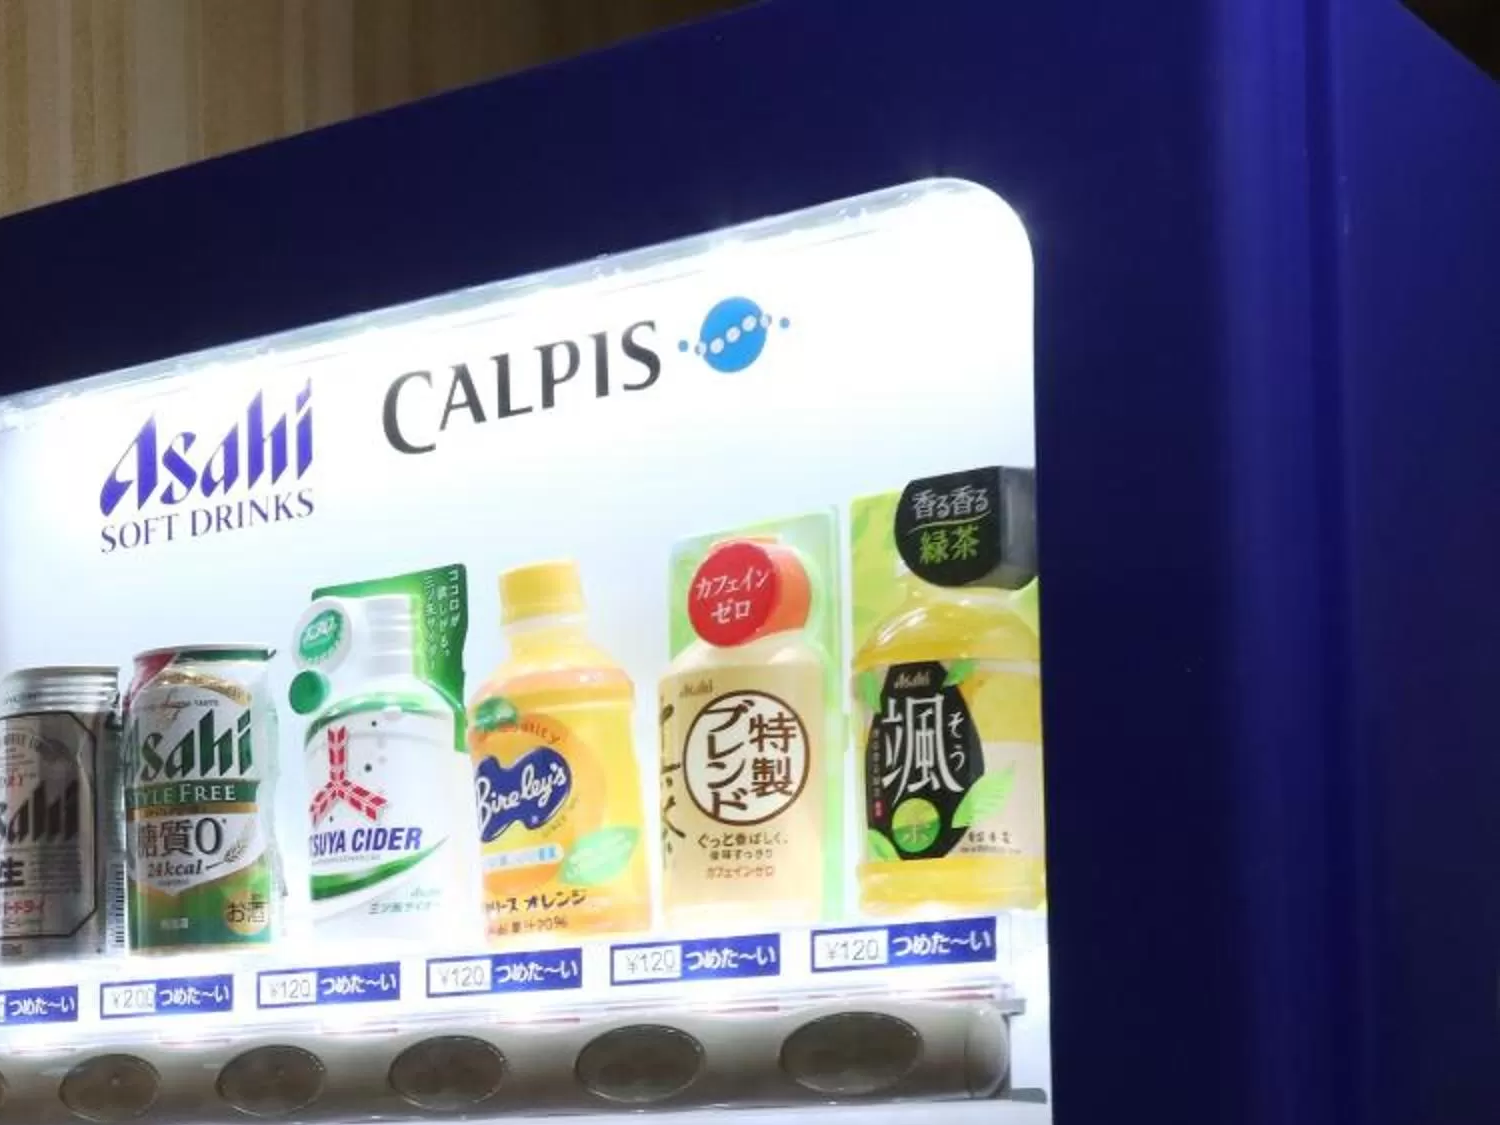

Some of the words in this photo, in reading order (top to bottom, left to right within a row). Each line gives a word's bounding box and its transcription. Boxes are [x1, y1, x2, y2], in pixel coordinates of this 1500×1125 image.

[382, 319, 662, 455] CALPIS
[100, 375, 314, 517] Asahi
[912, 484, 990, 521] 香る香る
[101, 512, 180, 554] SOFT
[190, 488, 315, 537] DRINKS
[920, 523, 981, 565] 緑茶
[696, 567, 770, 601] カフェイン
[710, 600, 752, 625] ゼロ
[749, 711, 797, 799] 特製
[947, 711, 966, 772] そう
[703, 700, 755, 818] ブレンド
[180, 783, 236, 803] FREE
[351, 827, 423, 854] CIDER
[524, 891, 588, 912] オレンジ
[625, 949, 677, 975] ¥120
[824, 938, 881, 963] ¥120
[269, 978, 312, 1000] ¥120
[438, 966, 485, 988] ¥120
